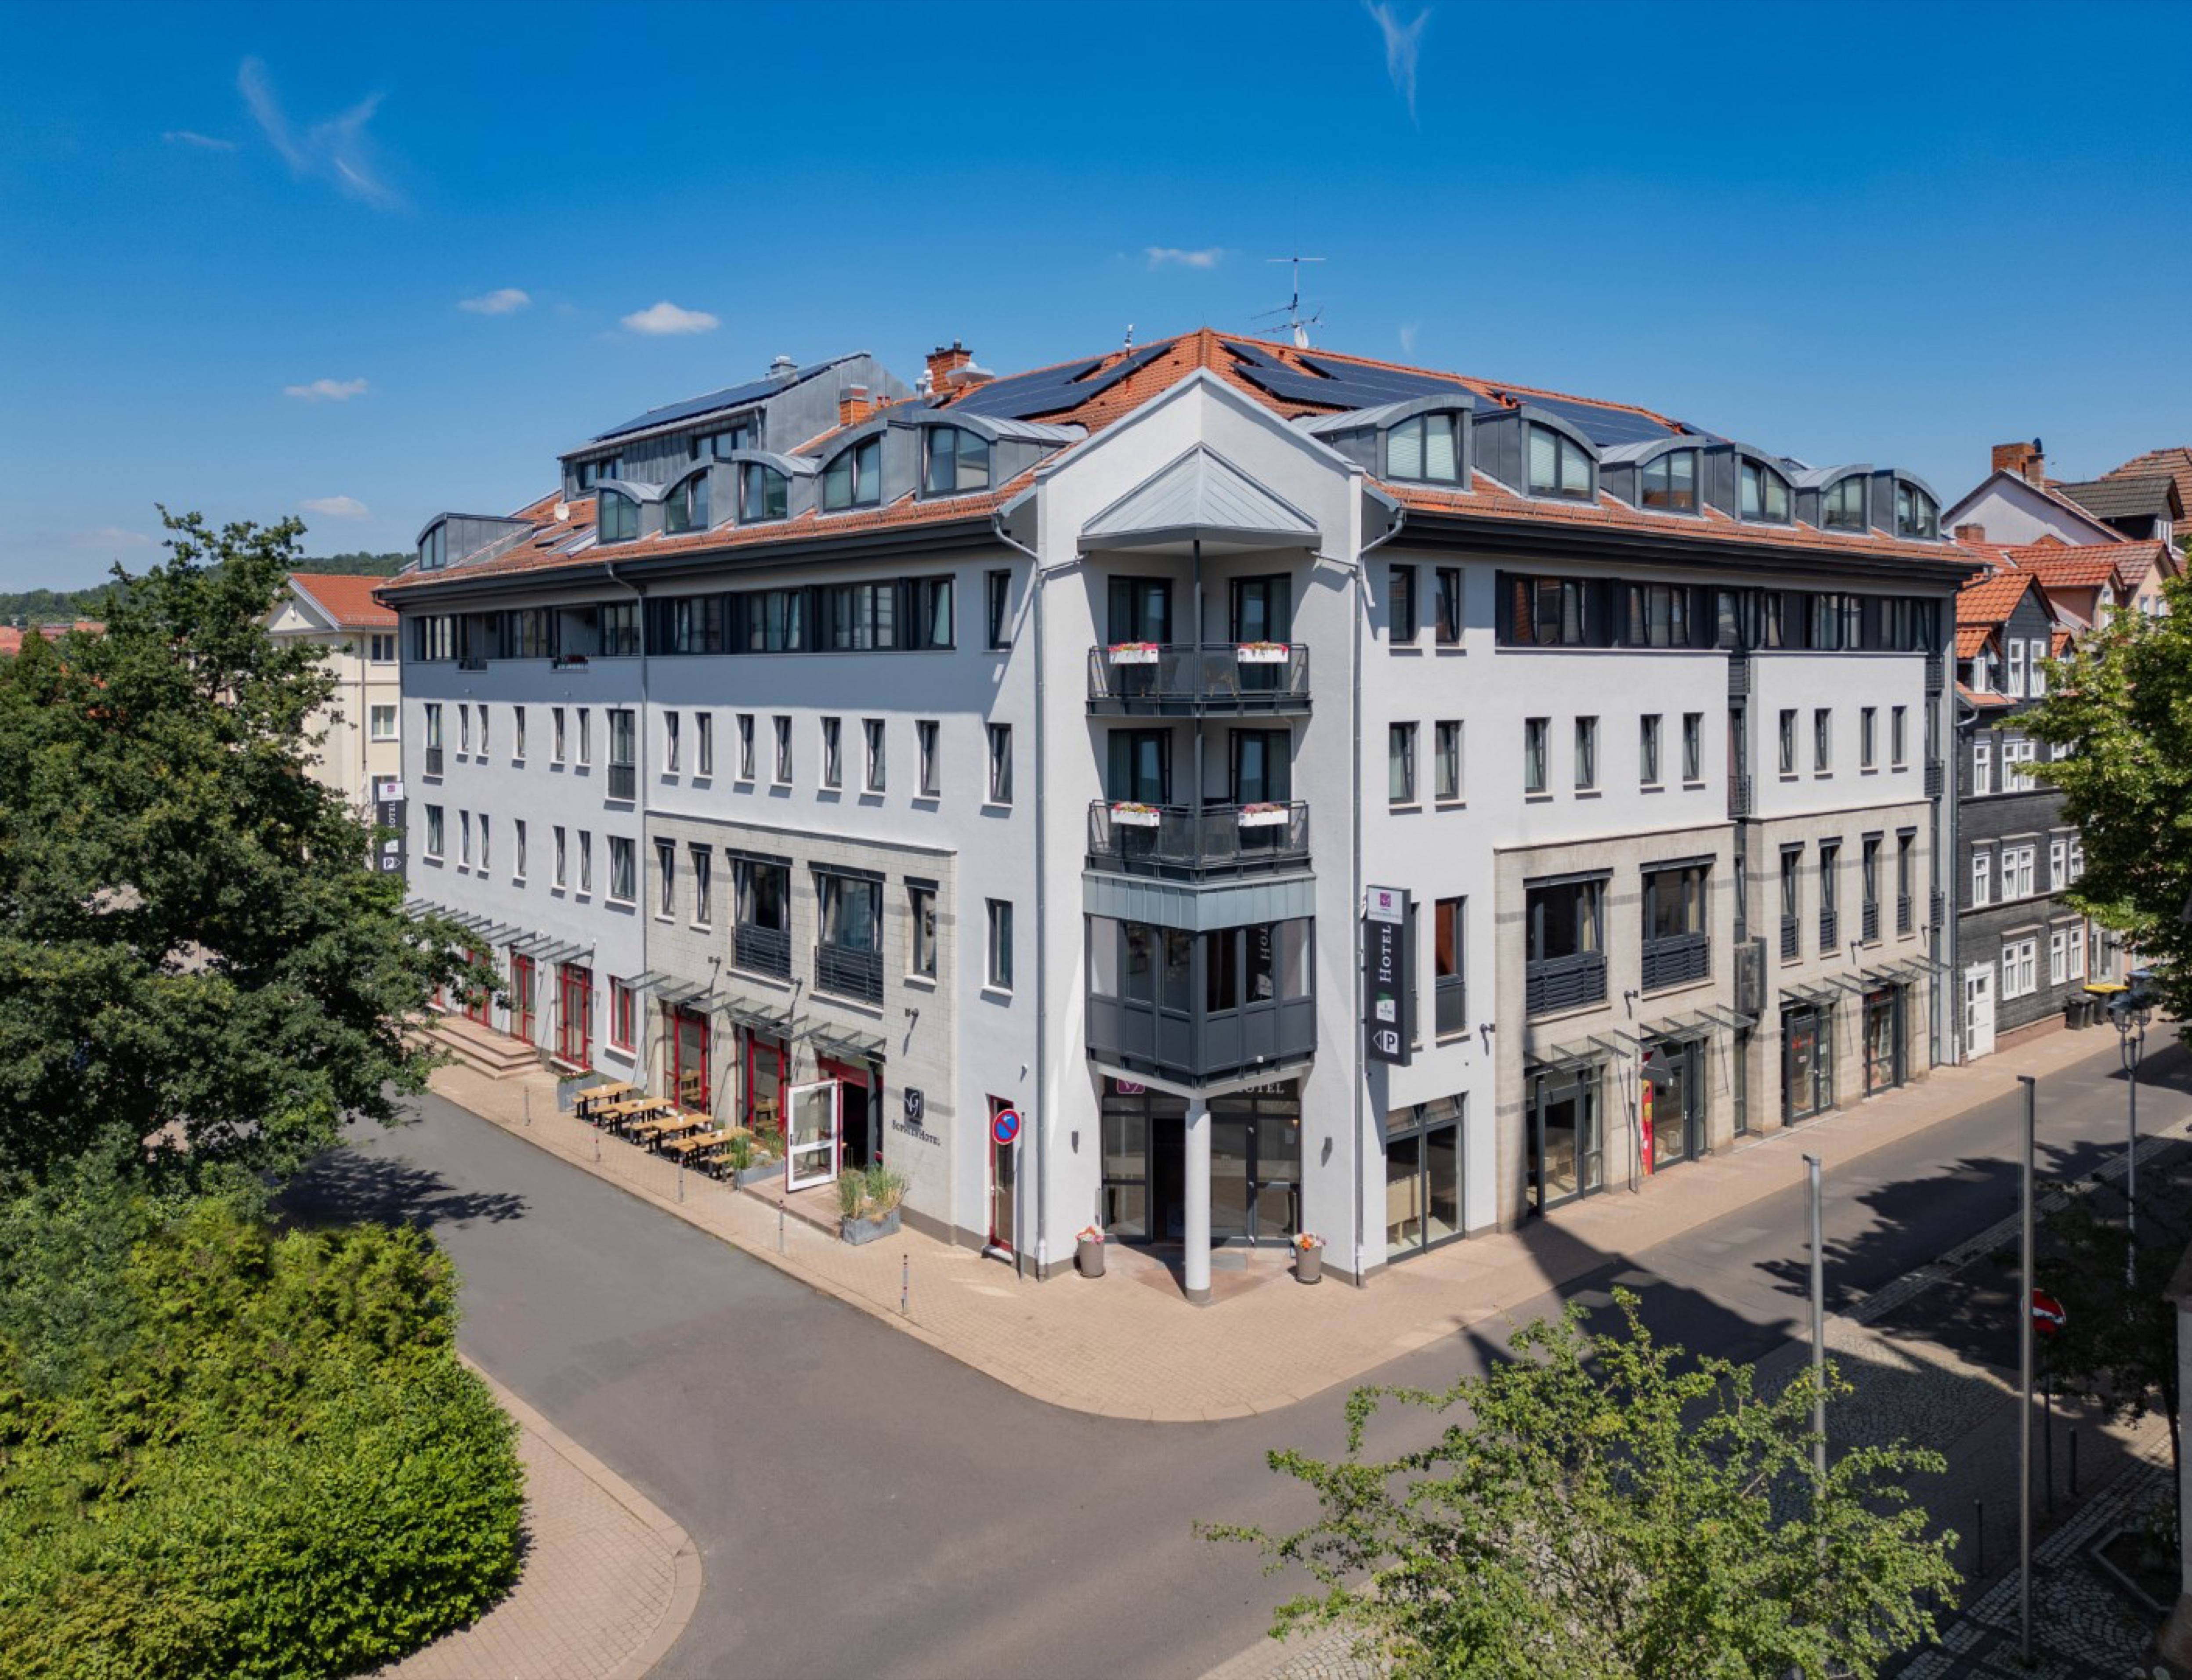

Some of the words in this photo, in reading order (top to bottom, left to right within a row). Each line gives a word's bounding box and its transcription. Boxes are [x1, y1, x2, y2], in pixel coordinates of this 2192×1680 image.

[1379, 925, 1391, 983] HOTEL
[1386, 1033, 1395, 1051] P
[1241, 1082, 1284, 1094] OTEL
